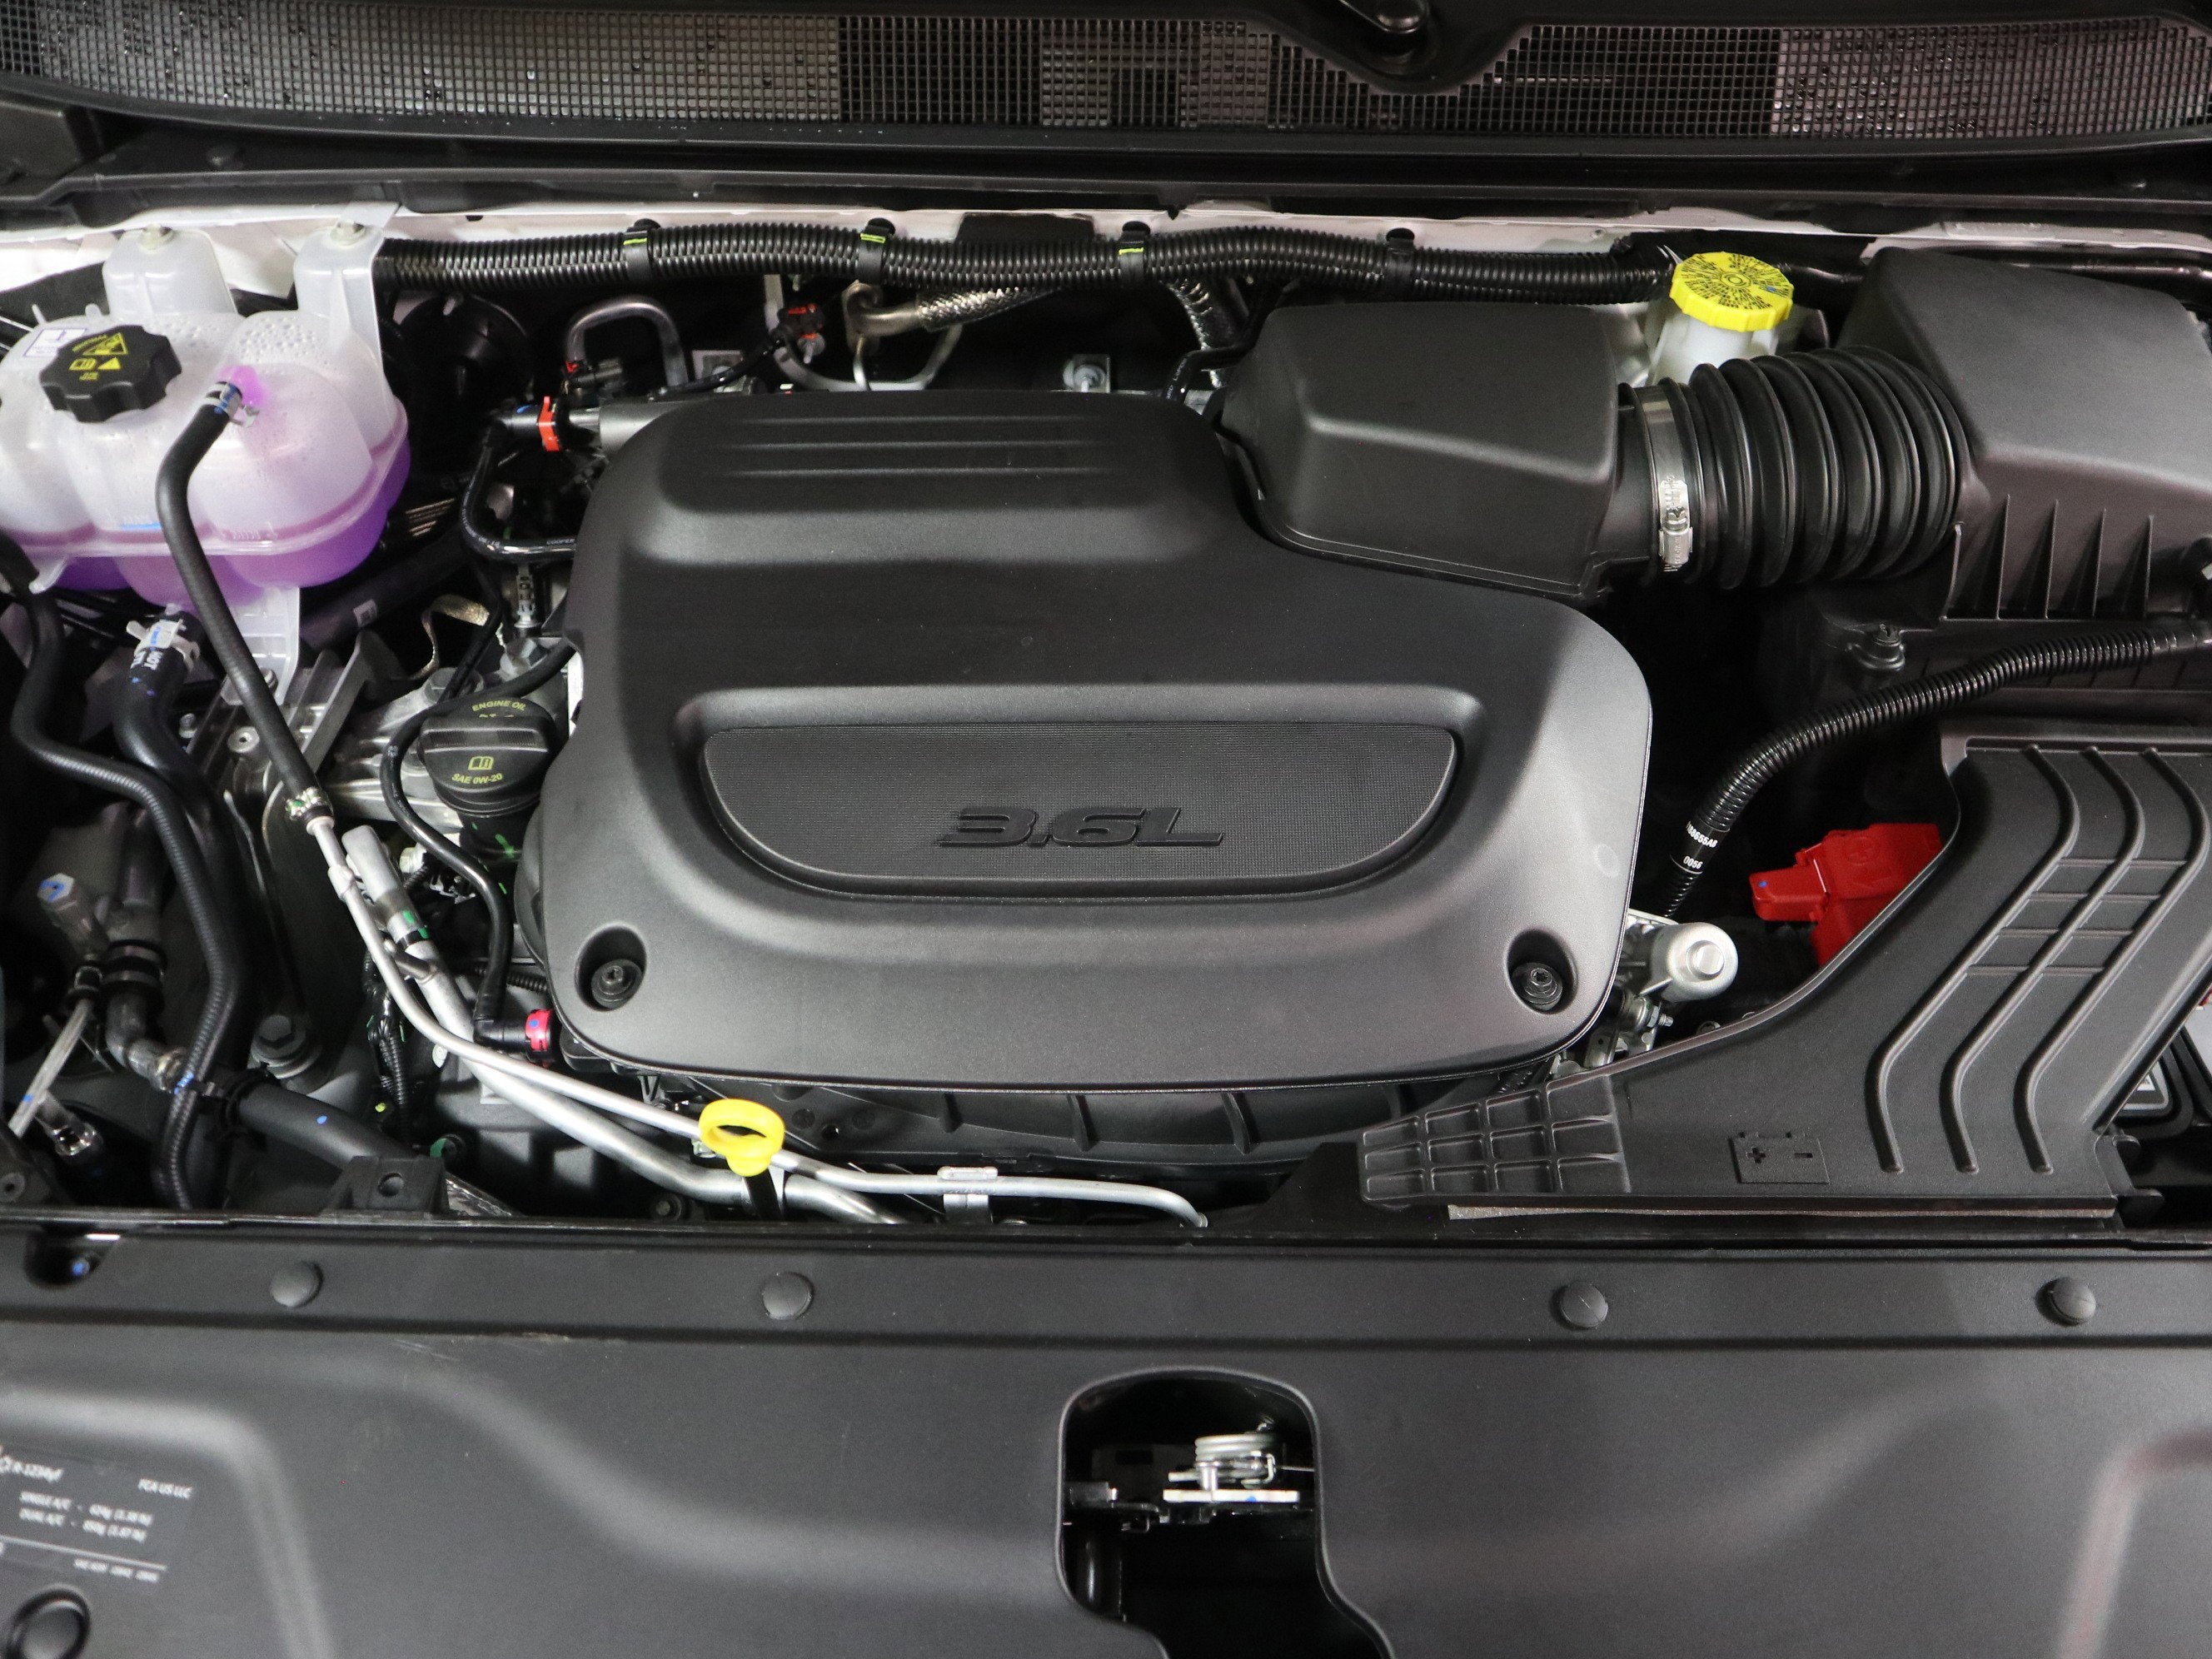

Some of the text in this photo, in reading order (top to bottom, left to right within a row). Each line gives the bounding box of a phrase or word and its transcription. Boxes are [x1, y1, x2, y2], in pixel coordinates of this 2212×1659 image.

[472, 700, 526, 711] ENGINE OIL
[452, 773, 502, 784] SAE 0W-20
[934, 807, 1224, 848] 3.6L
[1683, 855, 1703, 869] 0056
